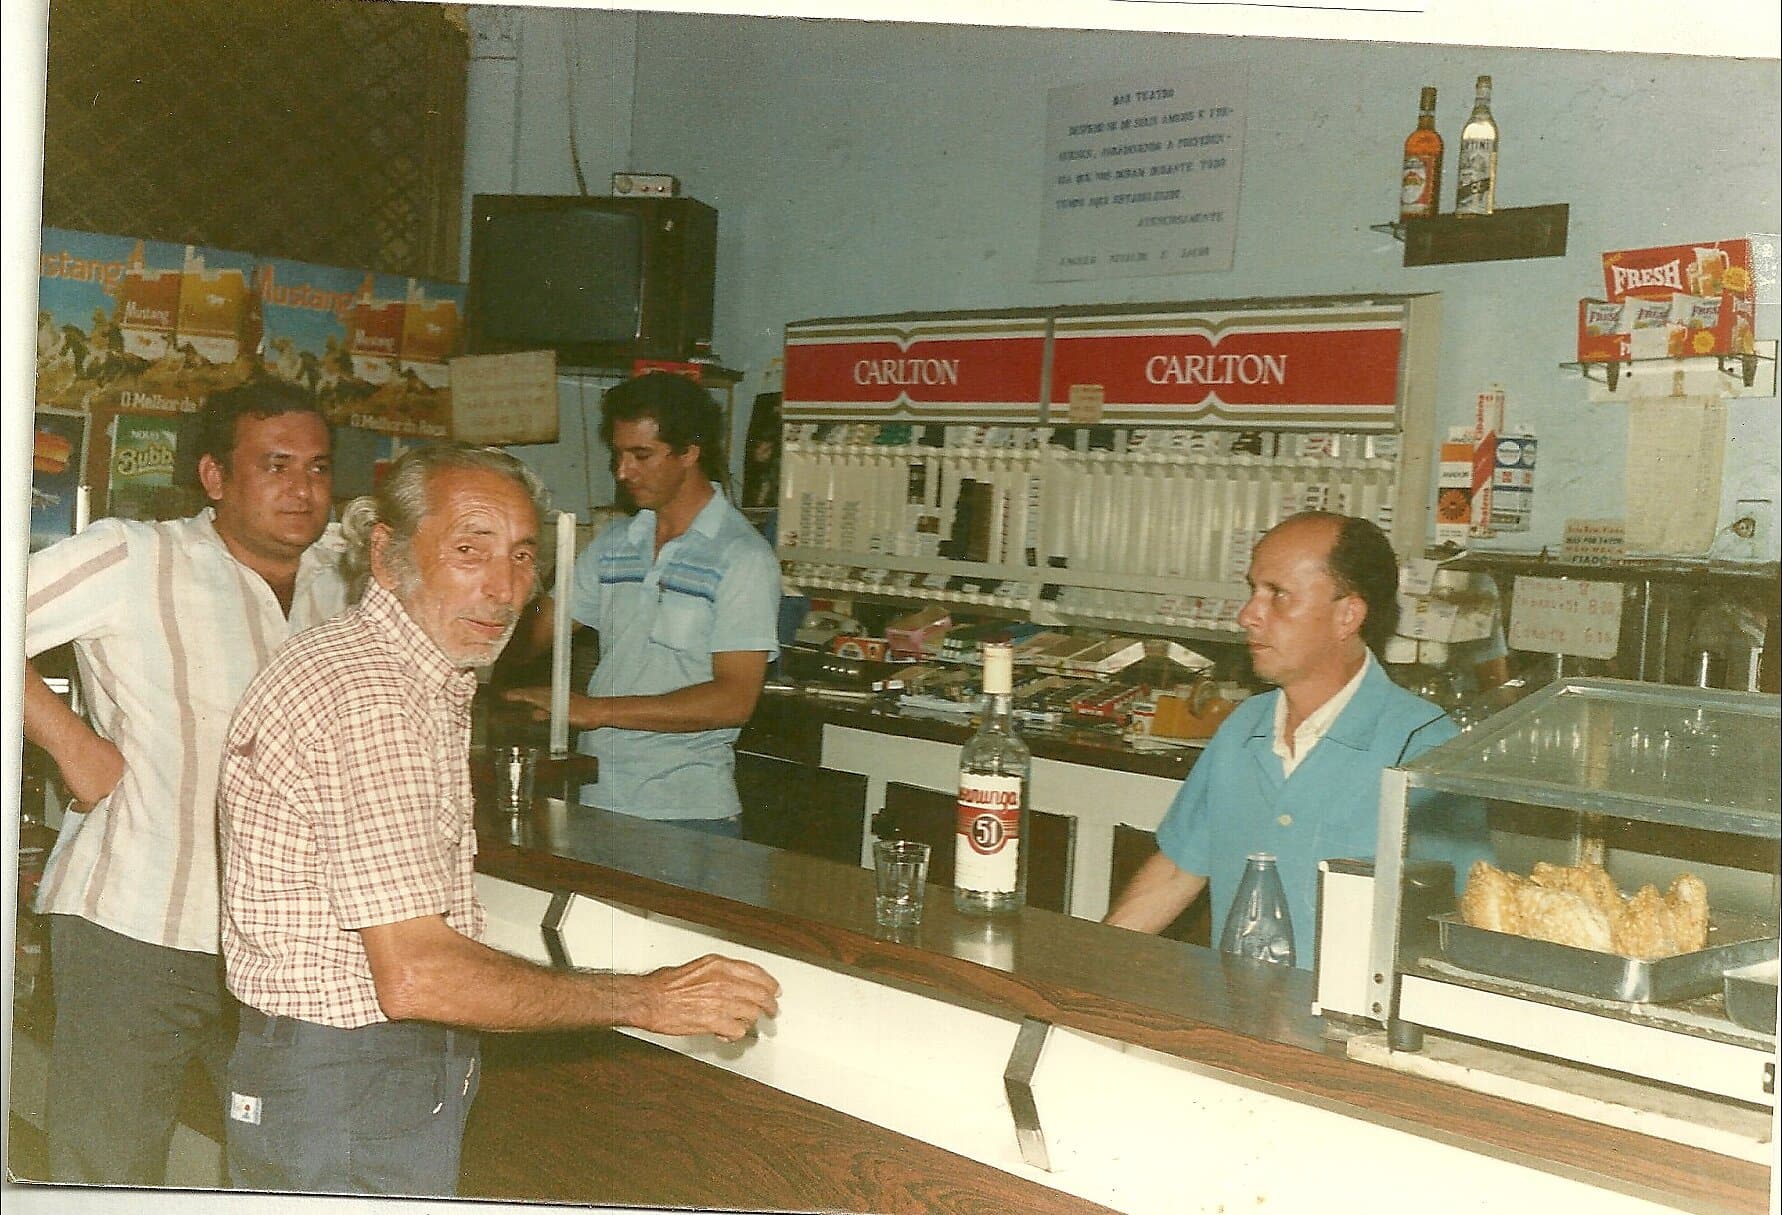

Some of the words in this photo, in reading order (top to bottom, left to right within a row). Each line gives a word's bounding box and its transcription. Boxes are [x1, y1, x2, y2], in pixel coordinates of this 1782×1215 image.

[42, 249, 125, 297] stang
[1611, 259, 1683, 296] FRESH
[853, 359, 959, 385] CARLTON
[1145, 354, 1288, 384] CARLTON
[976, 820, 998, 844] 51
